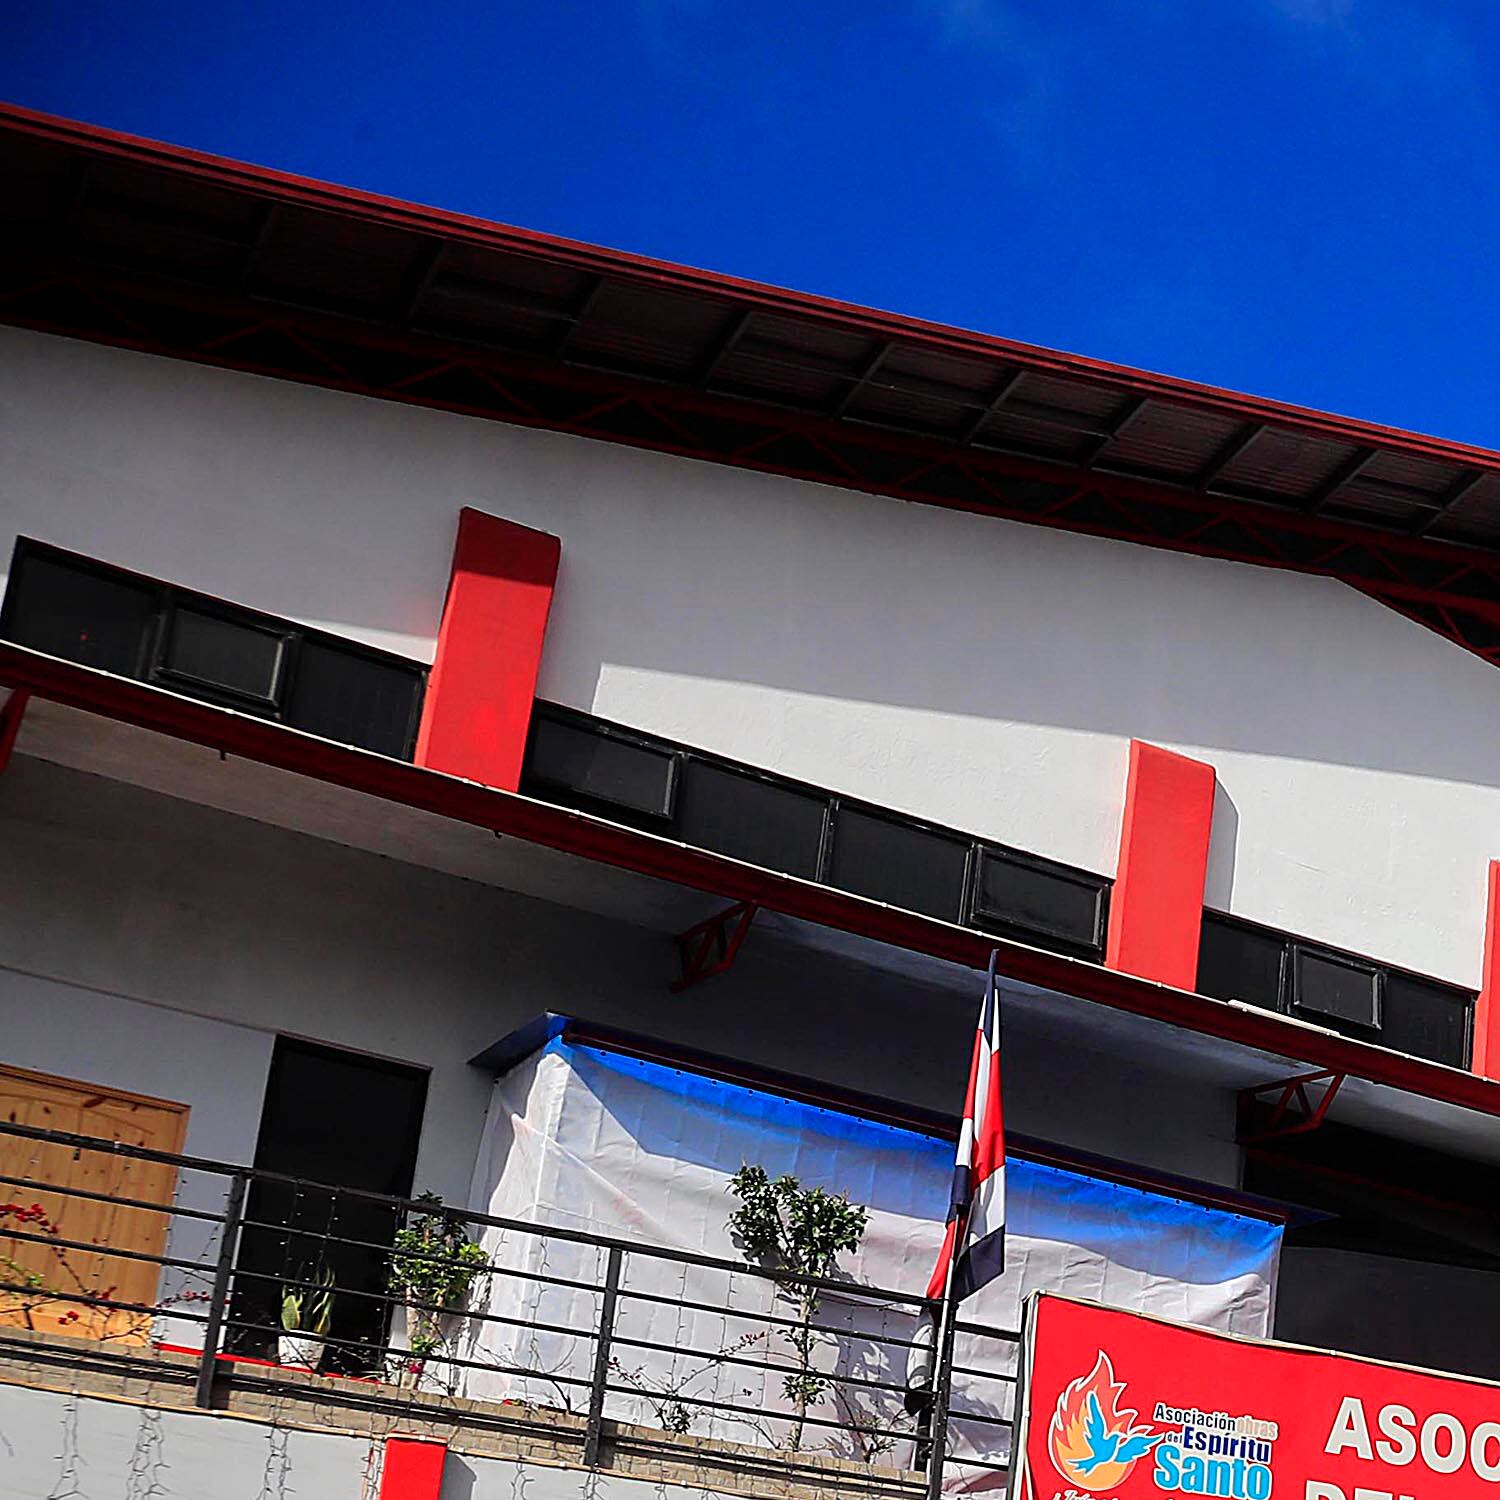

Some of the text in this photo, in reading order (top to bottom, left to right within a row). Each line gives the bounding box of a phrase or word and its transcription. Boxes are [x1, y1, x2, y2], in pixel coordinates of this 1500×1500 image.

[1155, 1403, 1277, 1438] Asociación obras
[1166, 1426, 1270, 1462] del Espíritu
[1156, 1444, 1271, 1500] Santo
